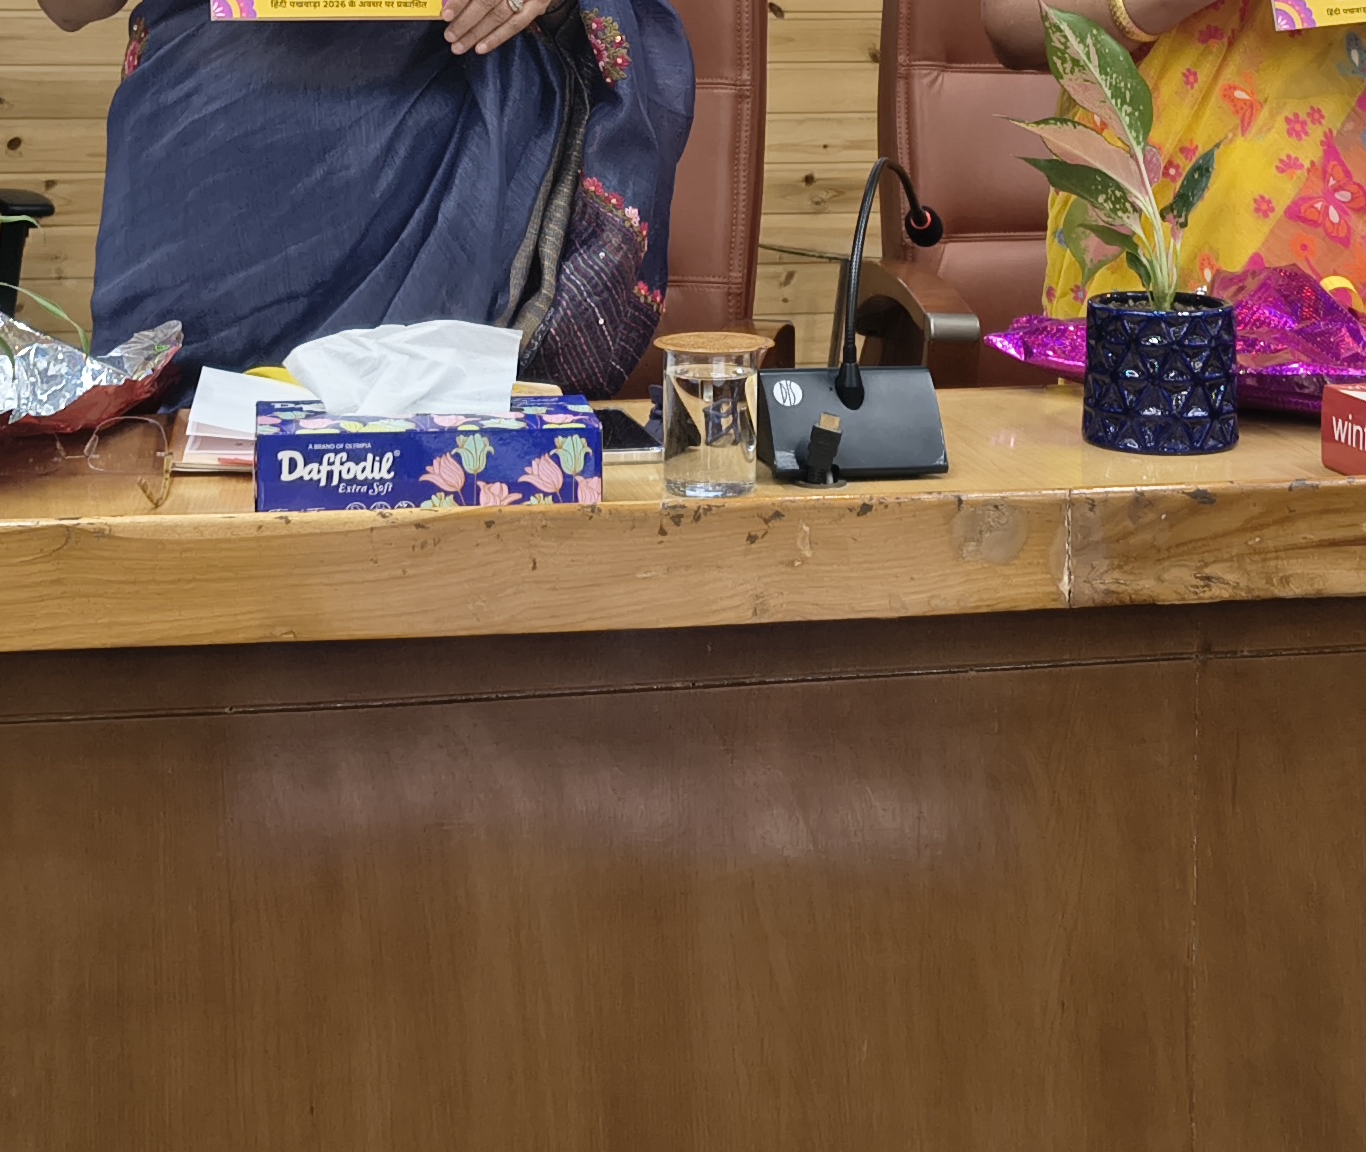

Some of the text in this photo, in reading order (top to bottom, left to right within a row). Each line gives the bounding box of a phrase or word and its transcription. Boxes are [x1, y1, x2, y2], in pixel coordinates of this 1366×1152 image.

[323, 0, 346, 8] 2026
[277, 450, 395, 487] Daffodil
[338, 482, 393, 495] Extra Soft
